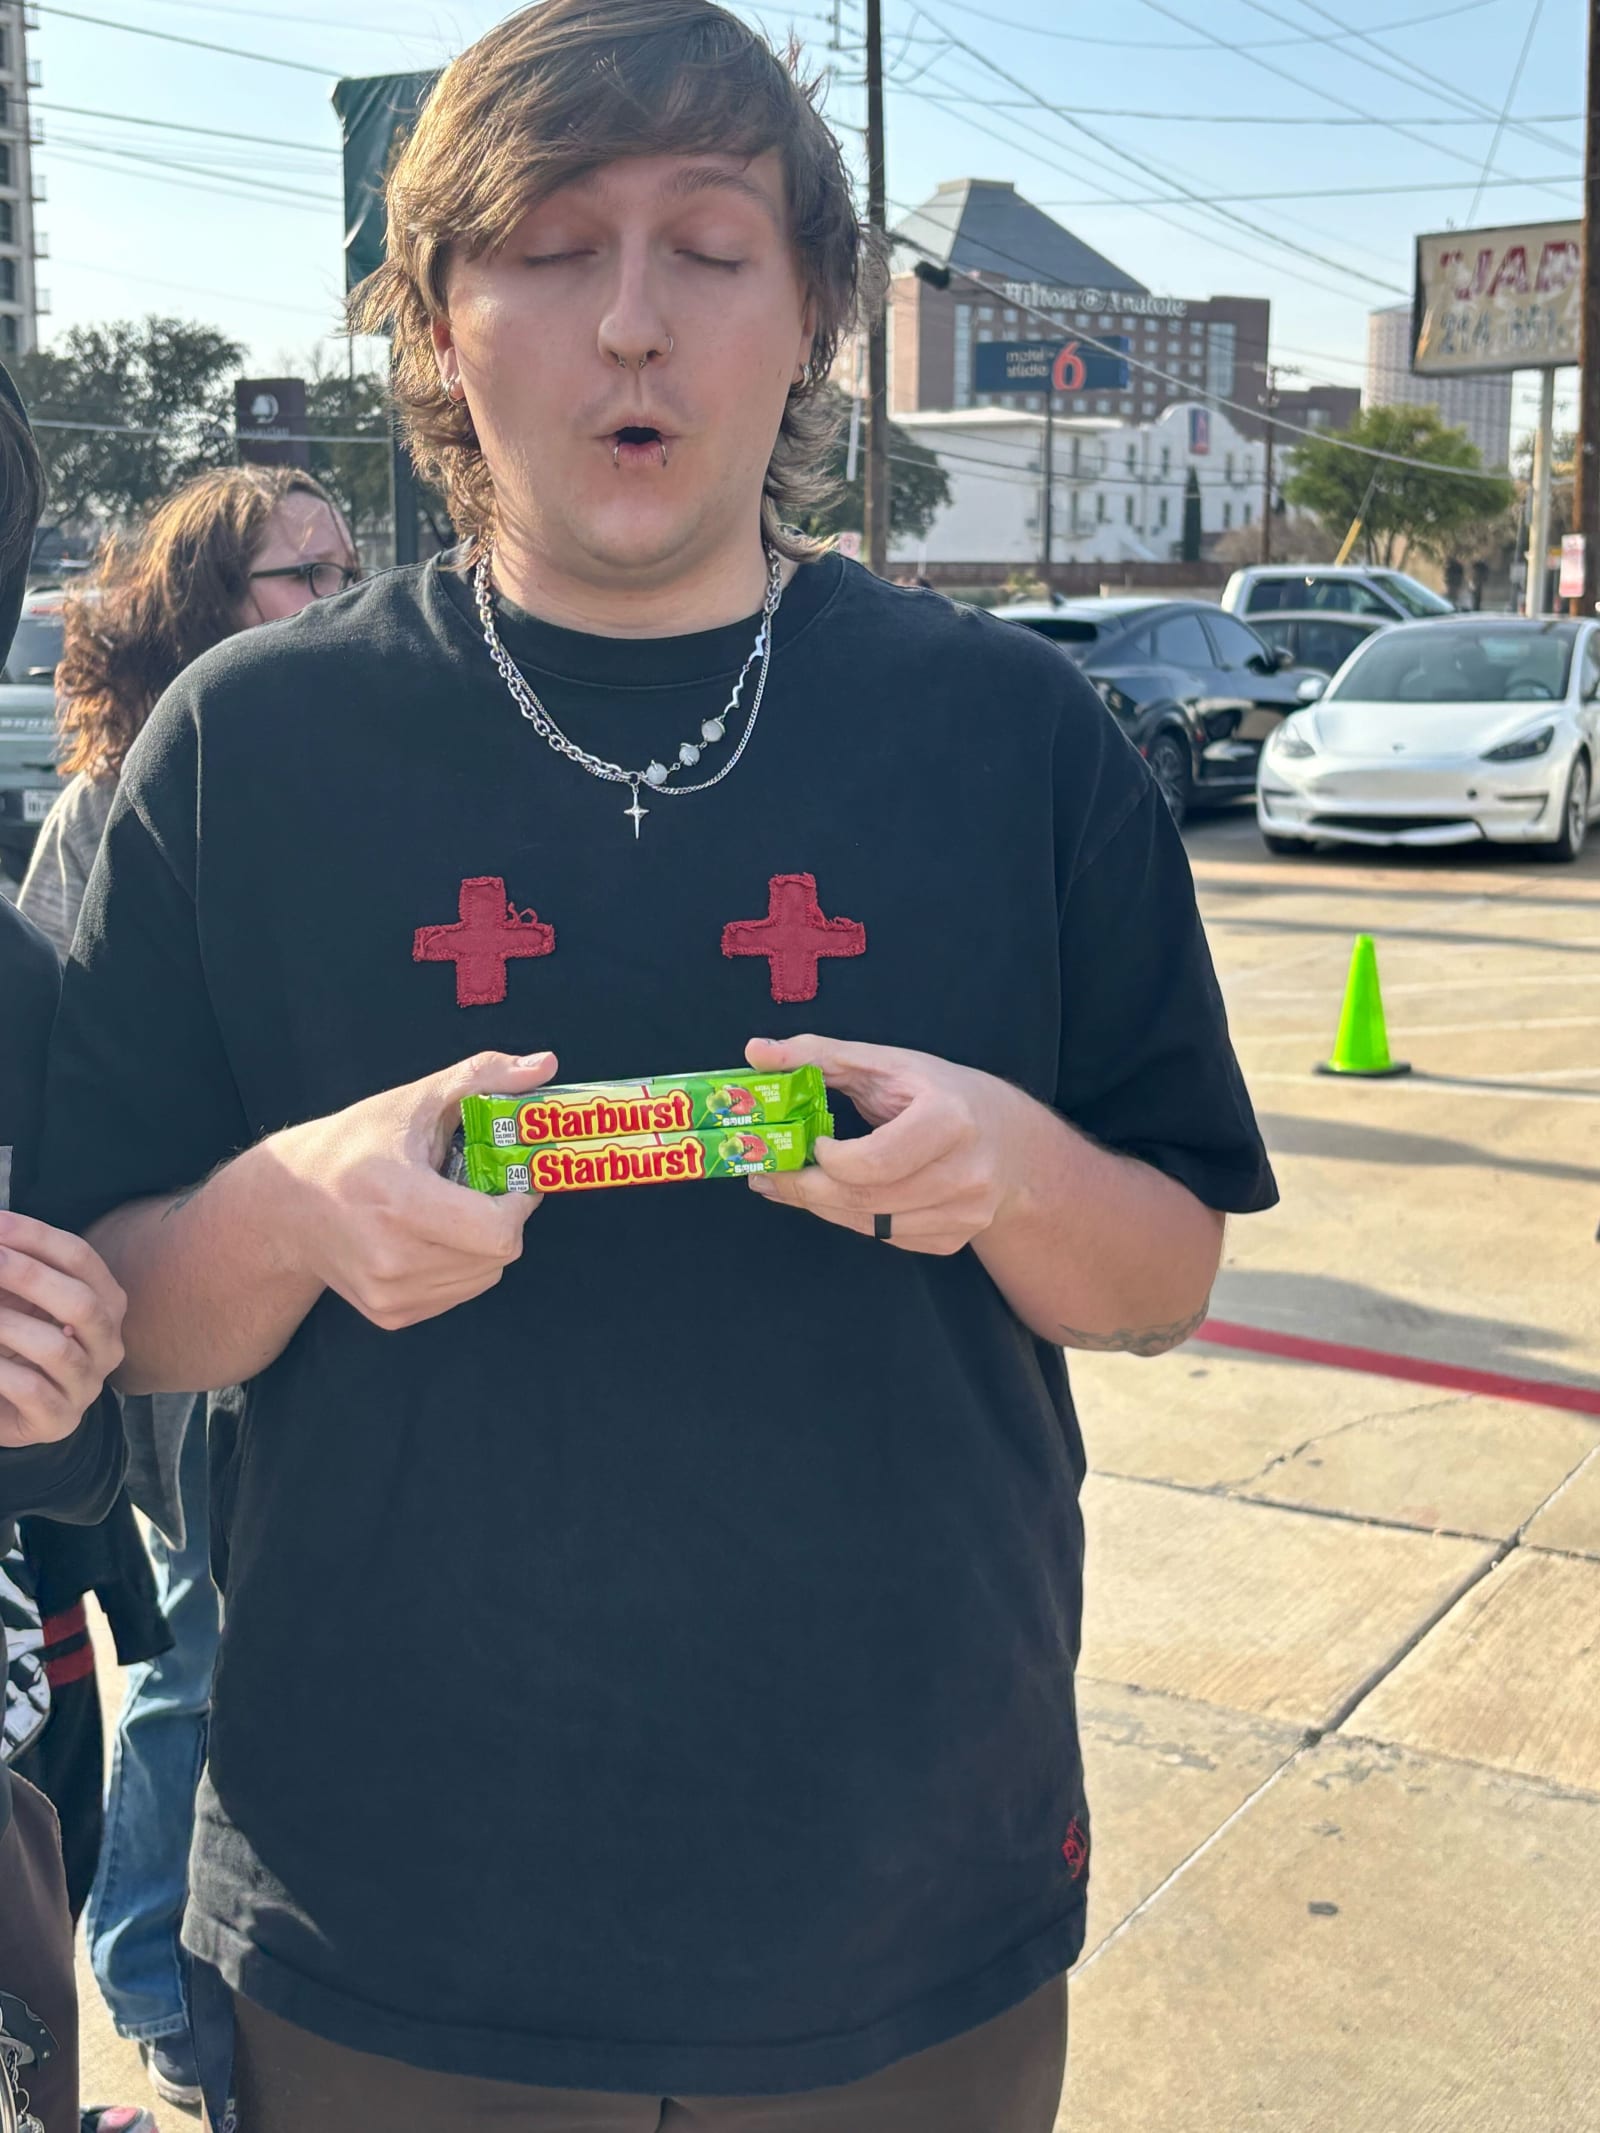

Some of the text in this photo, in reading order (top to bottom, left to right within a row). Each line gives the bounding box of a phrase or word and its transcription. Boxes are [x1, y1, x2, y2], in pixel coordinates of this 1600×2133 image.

[1052, 339, 1086, 391] 6
[494, 1120, 514, 1133] 240
[525, 1095, 685, 1140] Starburst
[508, 1167, 527, 1180] 240
[537, 1142, 698, 1187] Starburst
